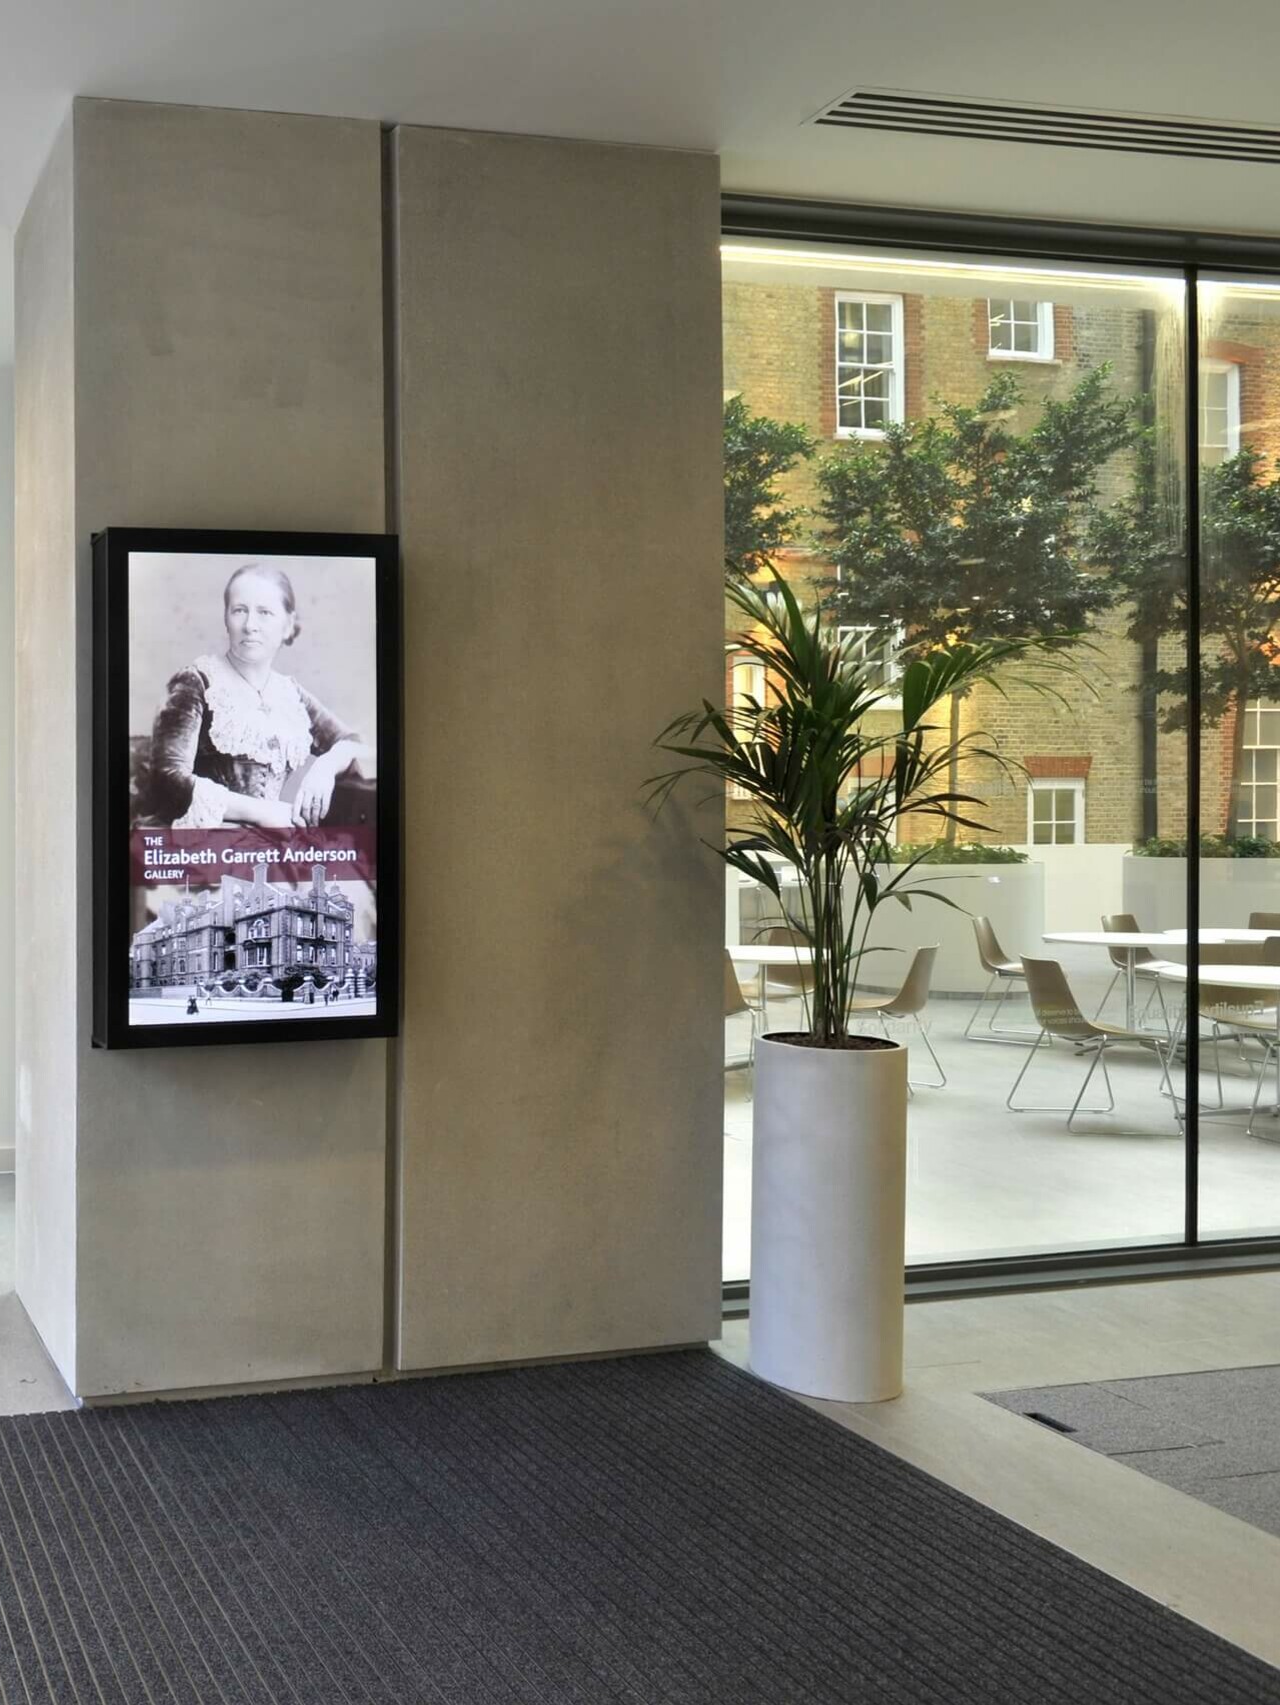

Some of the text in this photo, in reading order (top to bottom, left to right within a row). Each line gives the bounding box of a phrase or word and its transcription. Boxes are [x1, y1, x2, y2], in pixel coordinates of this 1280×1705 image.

[144, 836, 163, 846] THE
[144, 846, 357, 865] Elizabeth Garrett Anderson
[144, 869, 185, 880] GALLERY
